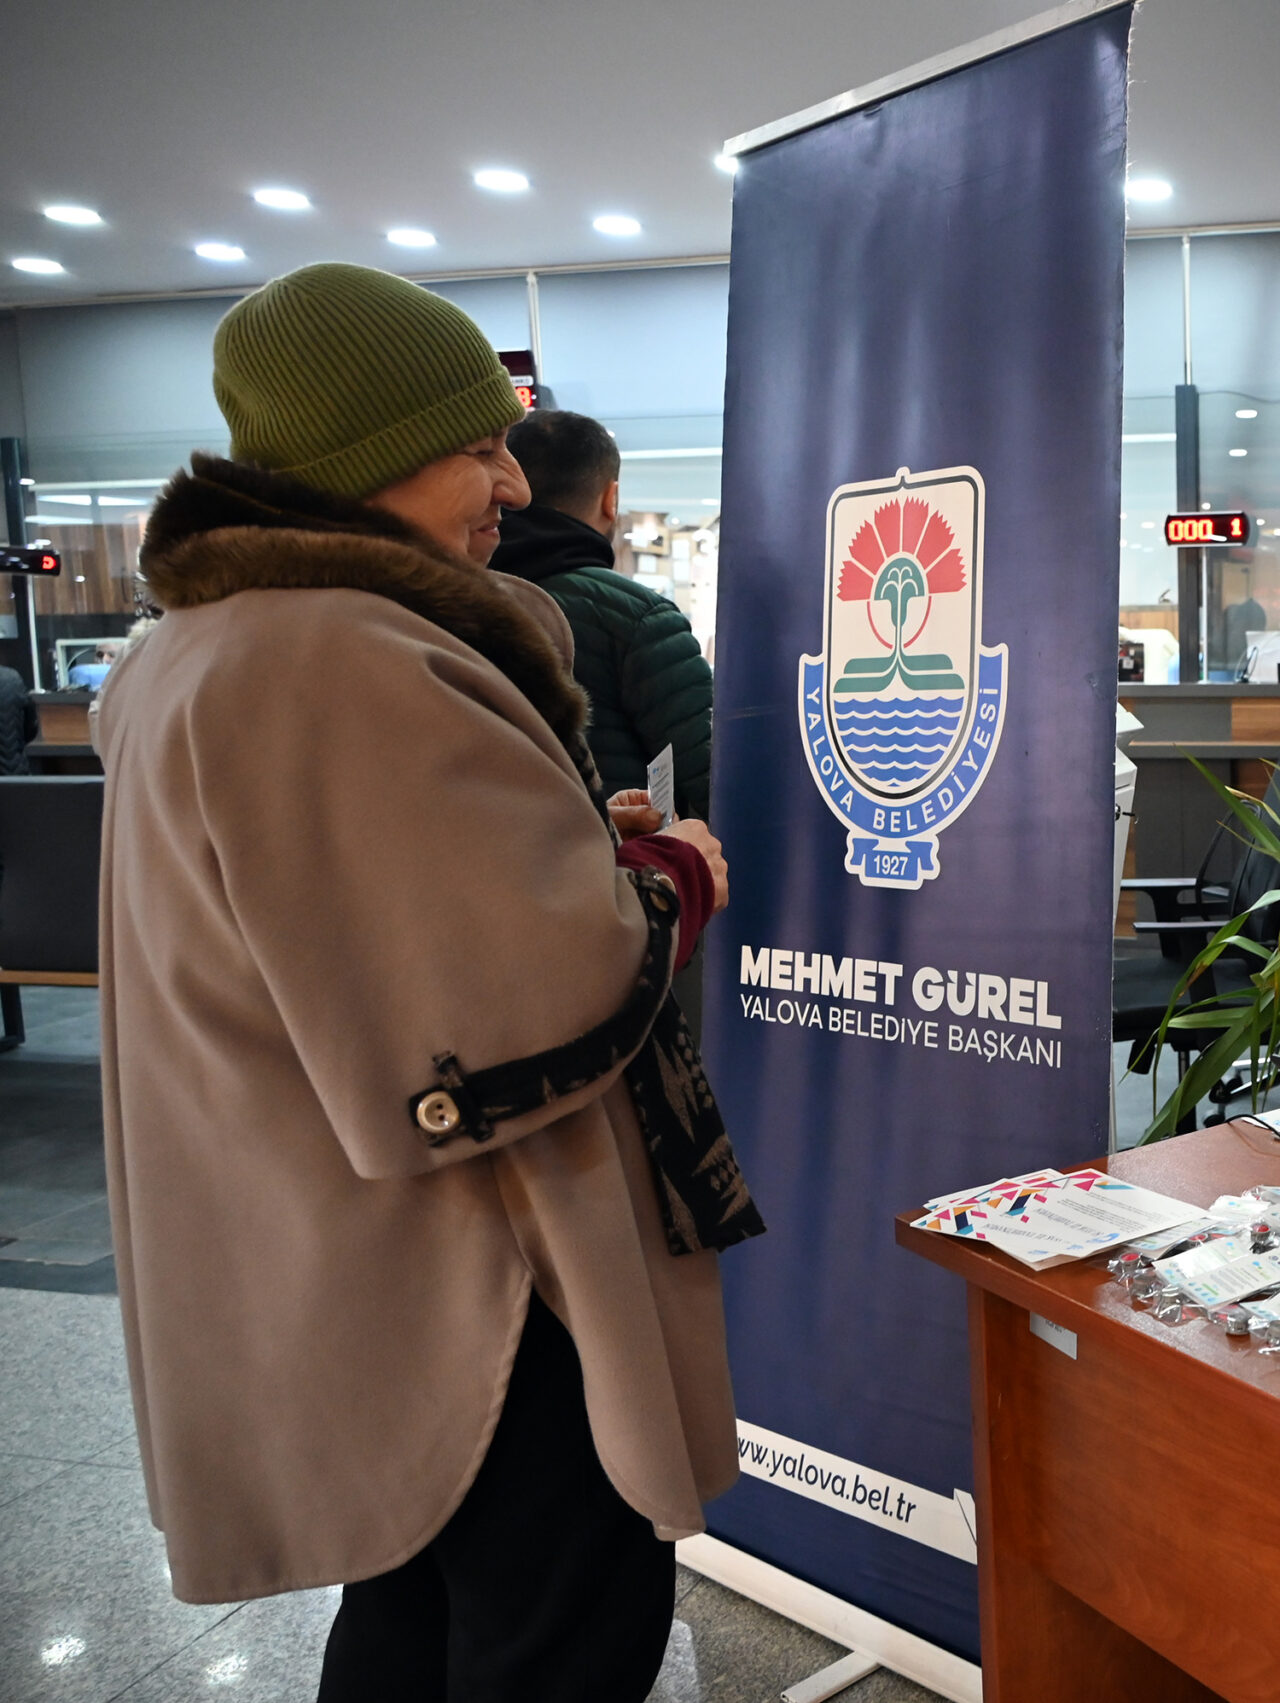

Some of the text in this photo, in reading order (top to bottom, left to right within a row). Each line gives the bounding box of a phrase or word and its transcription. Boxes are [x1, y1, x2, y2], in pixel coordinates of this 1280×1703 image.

[1168, 517, 1242, 541] 000 1
[807, 687, 999, 833] YALOVA BELEDİYESİ
[874, 855, 908, 876] 1927
[740, 945, 1062, 1030] MEHMET GÜREL
[740, 994, 1062, 1068] YALOVA BELEDİYE BAŞKANI
